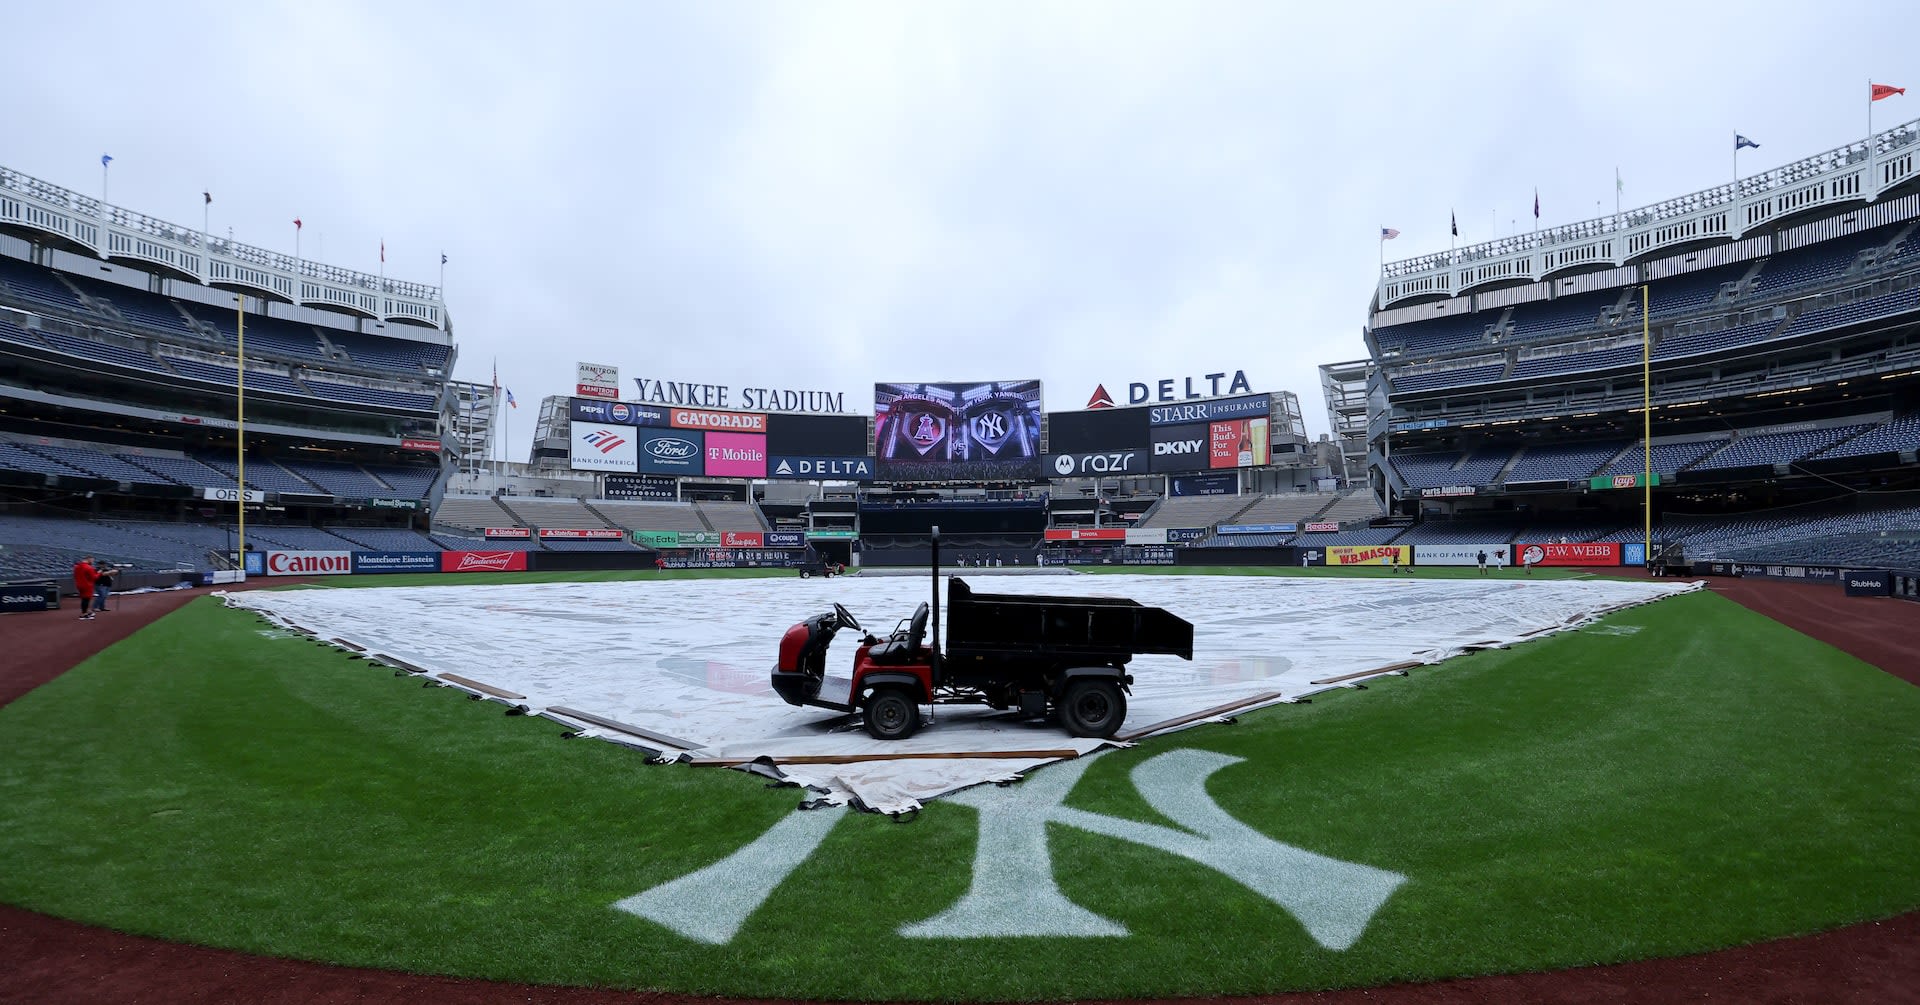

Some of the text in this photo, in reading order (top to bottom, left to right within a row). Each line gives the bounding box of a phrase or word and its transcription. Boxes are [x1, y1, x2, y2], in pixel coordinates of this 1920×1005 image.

[580, 364, 617, 375] ARMITRON
[582, 384, 614, 394] ARMITRON
[1129, 369, 1250, 404] DELTA
[633, 378, 844, 413] YANKEE STADIUM
[973, 392, 993, 402] YORK
[580, 406, 604, 414] PEPSI
[1151, 400, 1268, 423] STARR INSURANCE
[676, 411, 762, 429] GATORADE
[1212, 424, 1232, 432] This
[1213, 432, 1236, 441] Bud's
[654, 440, 688, 456] Ford
[1154, 439, 1203, 455] DKNY
[1213, 441, 1228, 449] For
[709, 448, 762, 462] T Mobile
[1212, 450, 1232, 458] You.
[800, 461, 868, 474] DELTA
[1081, 453, 1135, 472] razr
[216, 490, 252, 500] ORS
[1442, 486, 1476, 494] Authority
[395, 500, 416, 508] Spring
[1306, 523, 1338, 531] Reebok
[1546, 546, 1568, 556] F.W.
[1572, 546, 1610, 556] WEBB
[269, 553, 349, 572] Canon
[358, 555, 401, 564] Montefiore
[464, 556, 508, 566] Budweiser
[1766, 566, 1805, 578] YANKEE STADIUM
[2, 595, 45, 603] StubHub
